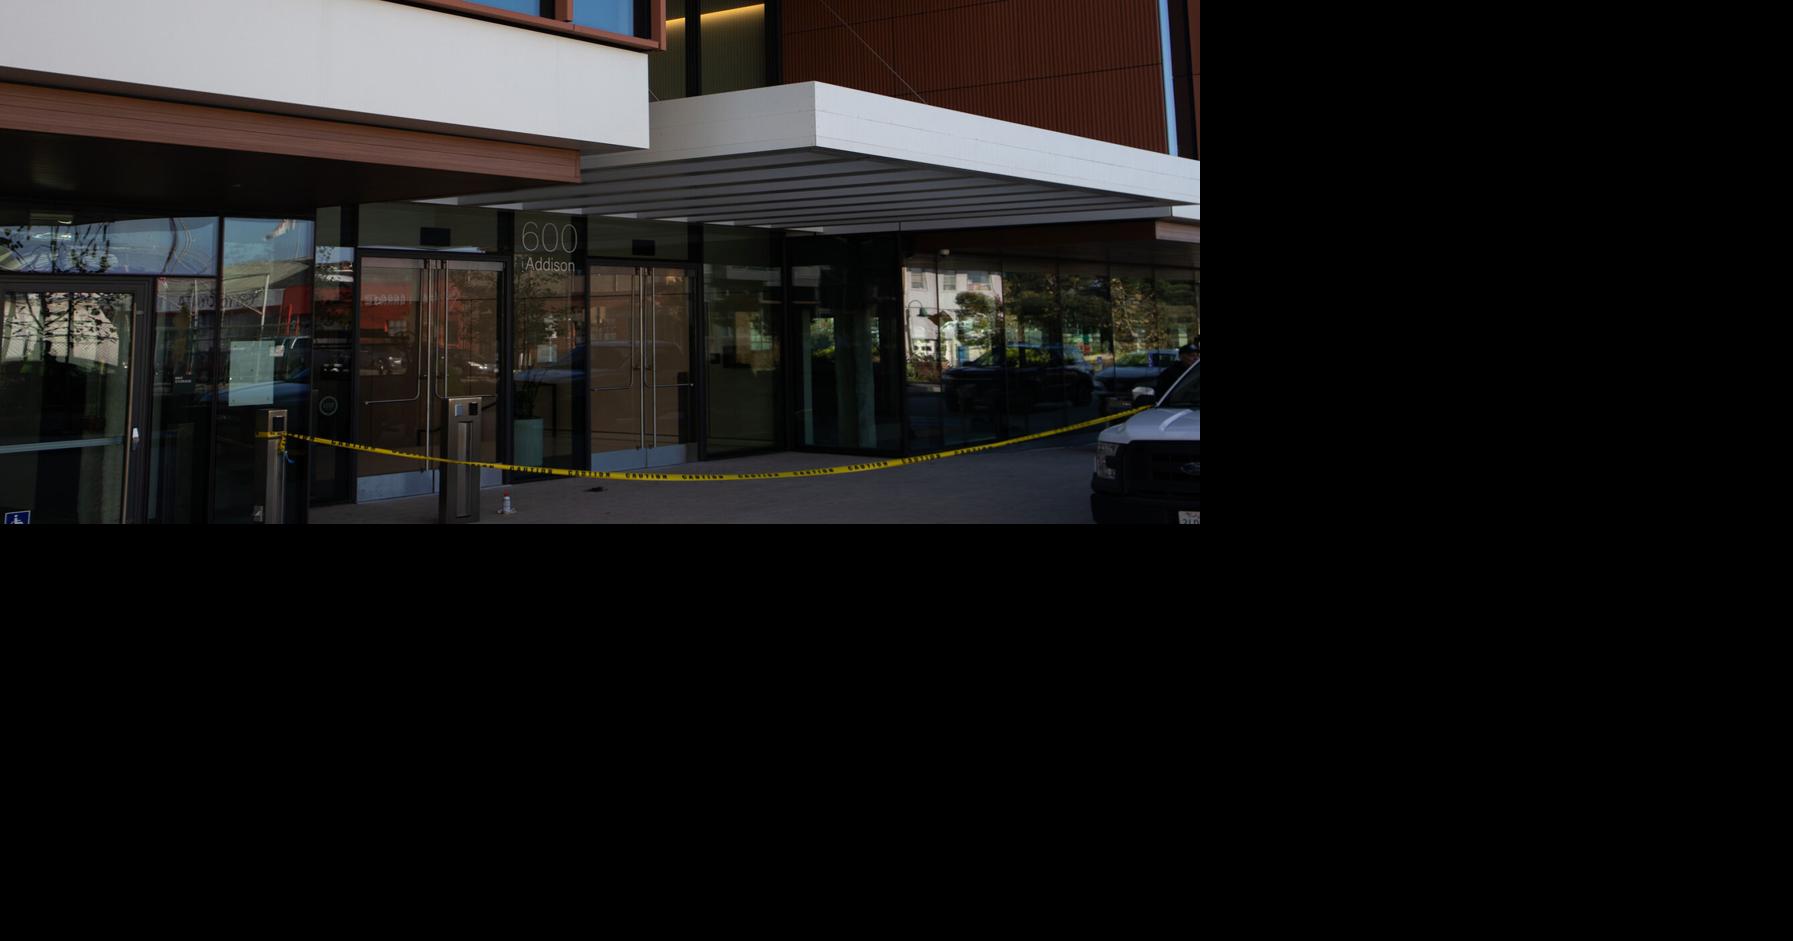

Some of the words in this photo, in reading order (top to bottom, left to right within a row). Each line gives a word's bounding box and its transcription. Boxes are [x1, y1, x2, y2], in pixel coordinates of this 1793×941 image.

[522, 221, 578, 254] 600
[525, 256, 576, 273] Addison
[625, 472, 668, 480] CAUTION
[848, 460, 888, 471] CAUTION
